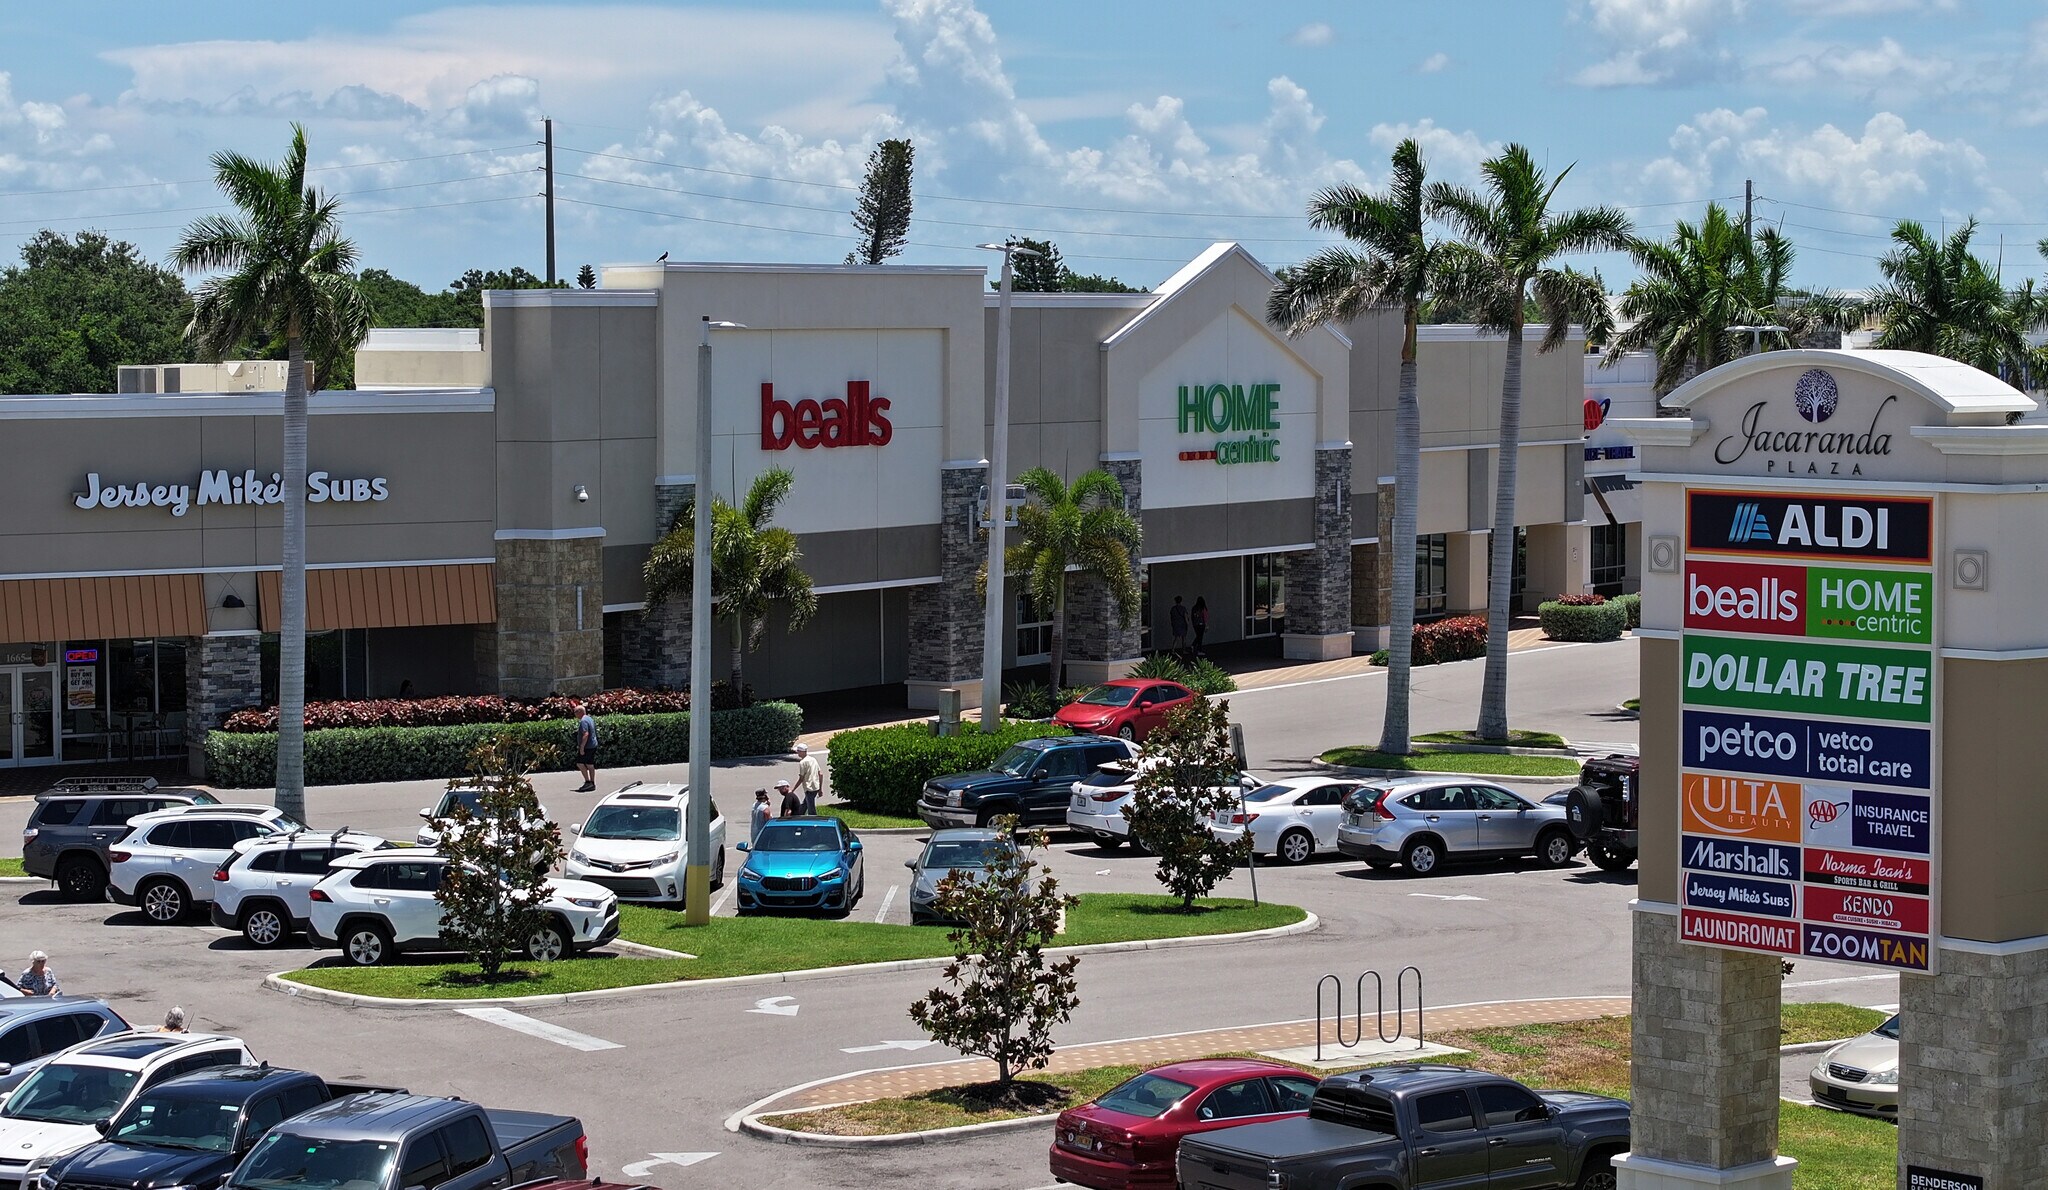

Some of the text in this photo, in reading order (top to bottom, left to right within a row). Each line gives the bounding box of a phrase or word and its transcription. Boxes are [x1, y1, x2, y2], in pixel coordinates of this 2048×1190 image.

[761, 380, 892, 450] bealls
[1177, 384, 1281, 434] HOME
[1714, 395, 1898, 465] Jacaranda
[1214, 432, 1281, 464] centric
[1767, 460, 1862, 476] PLAZA
[75, 472, 190, 517] Jersey
[308, 471, 389, 503] SUBS
[1777, 504, 1889, 550] ALDI
[1689, 573, 1798, 621] bealls
[1821, 577, 1922, 614] HOME
[1856, 614, 1922, 635] centric
[68, 652, 96, 660] OPEN
[1687, 652, 1927, 705] DOLLAR TREE
[1699, 721, 1797, 762] petco
[1818, 732, 1873, 752] vetco
[1818, 753, 1912, 778] total care
[1702, 777, 1787, 819] ULTA
[1728, 814, 1792, 830] BEAUTY
[1810, 800, 1837, 823] AAA
[1854, 803, 1928, 824] INSURANCE
[1867, 821, 1915, 838] TRAVEL
[1819, 852, 1913, 880] Norma Jean's
[1689, 881, 1726, 903] Jersey
[1727, 886, 1761, 903] Mike's
[1834, 875, 1899, 890] SPORTS BAR & GRILL
[1842, 894, 1894, 917] KENDO
[1847, 915, 1864, 923] CUISINE
[1684, 915, 1795, 949] LAUNDROMAT
[1911, 1174, 1977, 1190] BENDERSON
